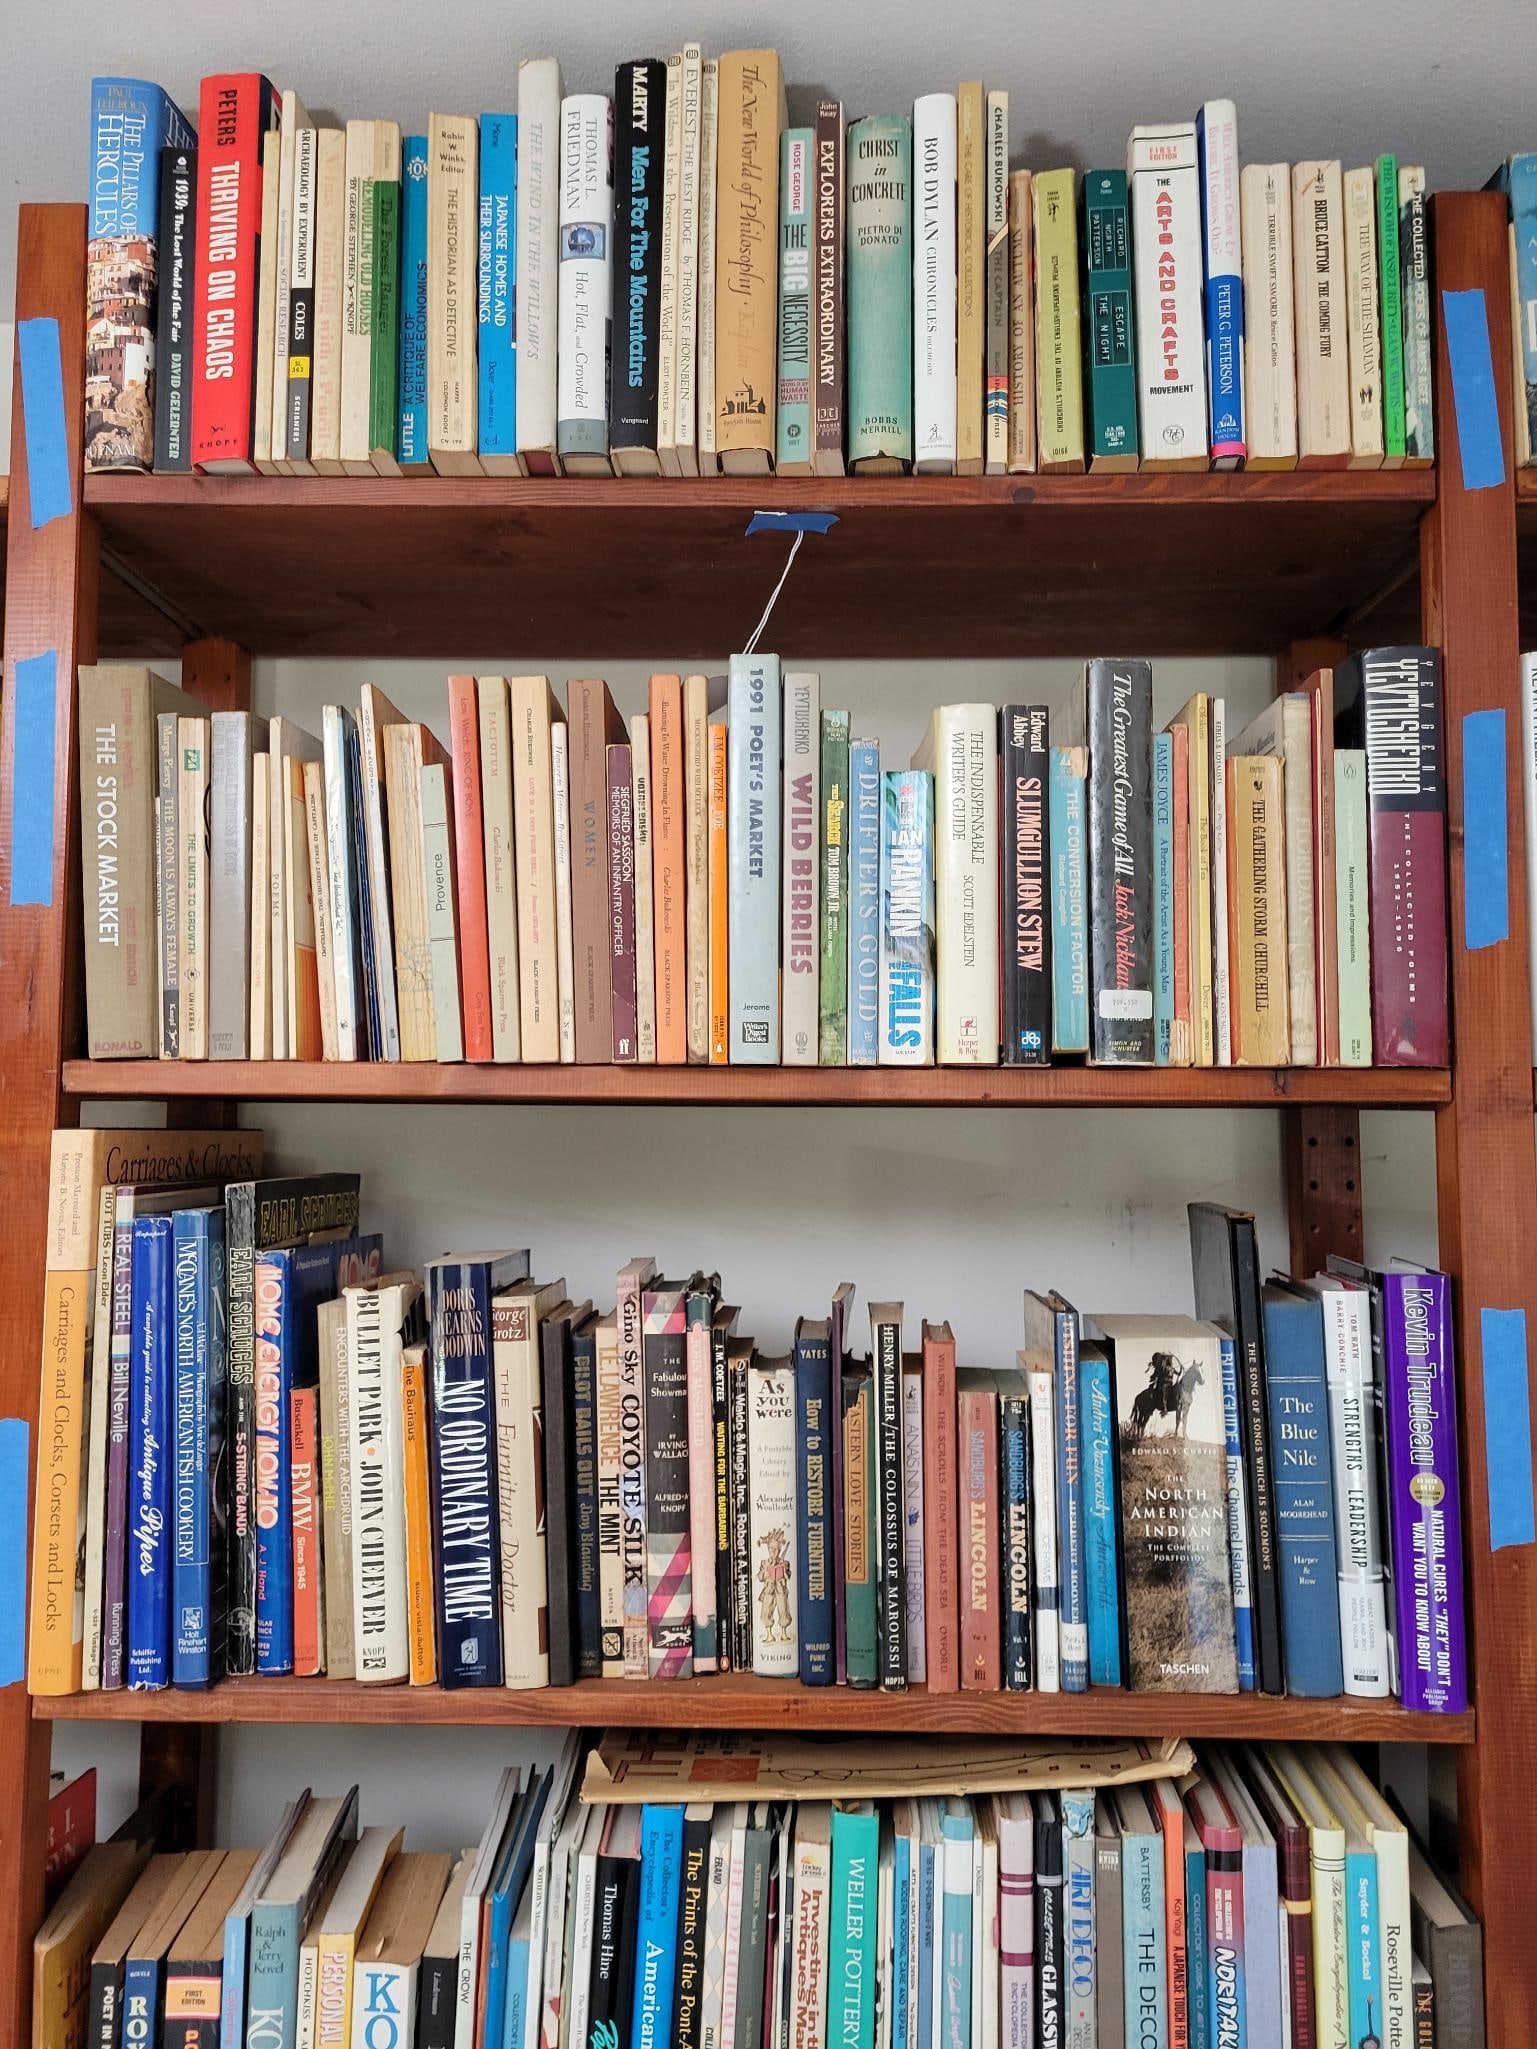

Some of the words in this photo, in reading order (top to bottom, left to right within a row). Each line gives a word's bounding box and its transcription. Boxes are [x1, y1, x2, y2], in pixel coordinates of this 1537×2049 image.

[216, 89, 237, 147] PETERS
[632, 66, 647, 132] MARTY
[123, 114, 145, 147] THE
[859, 140, 900, 159] CHRIST
[924, 137, 938, 173] BOB
[994, 107, 1003, 158] CHARLES
[94, 112, 121, 234] HERCULES
[121, 150, 144, 209] PILLARS
[297, 129, 311, 199] ARCHAEOLOGY
[631, 146, 648, 192] Men
[873, 163, 887, 176] in
[208, 161, 240, 262] THRIVING
[298, 202, 308, 215] BY
[630, 197, 648, 229] For
[820, 141, 835, 240] EXPLORERS
[852, 184, 907, 202] CONCRETE
[924, 180, 938, 242] DYLAN
[995, 160, 1003, 223] BUKOWSKI
[1314, 199, 1328, 231] BRUCE
[120, 212, 138, 234] OF
[783, 224, 808, 249] THE
[1156, 191, 1174, 246] ARTS
[297, 218, 307, 279] EXPERIMENT
[630, 232, 648, 271] The
[783, 250, 808, 291] BIG
[1158, 252, 1175, 292] AND
[1316, 234, 1330, 273] CATTON
[207, 270, 237, 301] ON
[927, 247, 937, 332] CHRONICLES
[1099, 296, 1108, 315] THE
[1218, 284, 1232, 318] PETER
[1318, 281, 1329, 297] THE
[295, 302, 305, 340] COLES
[628, 275, 647, 387] Mountains
[783, 294, 808, 363] NECESSITY
[820, 246, 835, 387] EXTRAORDINARY
[1115, 306, 1126, 348] ESCAPE
[1161, 299, 1179, 381] CRAFTS
[1219, 321, 1230, 333] G.
[1319, 300, 1330, 333] COMING
[205, 310, 234, 380] CHAOS
[1100, 326, 1110, 361] NIGHT
[1219, 336, 1234, 394] PETERSON
[1320, 335, 1331, 358] FURY
[169, 353, 182, 388] DAVID
[1150, 384, 1195, 394] MOVEMENT
[169, 391, 181, 459] GELERNTER
[293, 396, 301, 442] SCRIBNERS
[750, 668, 764, 712] 1991
[1112, 672, 1132, 706] The
[96, 724, 116, 764] THE
[794, 685, 811, 754] YEVTUSHENKO
[1011, 715, 1029, 748] Abbey
[1029, 712, 1045, 752] Edward
[1113, 708, 1133, 778] Greatest
[1366, 658, 1421, 795] YEVTUSHENKO
[749, 725, 764, 790] POET'S
[97, 776, 118, 849] STOCK
[620, 786, 630, 832] SIEGFRIED
[791, 773, 812, 851] WILD
[1114, 780, 1133, 832] Game
[1253, 799, 1264, 824] THE
[187, 833, 195, 852] THE
[584, 800, 596, 867] WOMEN
[622, 835, 632, 882] SASSOON
[749, 799, 763, 878] MARKET
[858, 772, 878, 918] DRIFTER'S
[1016, 777, 1042, 911] SLUMGULLION
[1112, 834, 1132, 846] of
[187, 855, 195, 893] LIMITS
[433, 853, 446, 911] Provence
[1115, 845, 1134, 874] All
[1253, 827, 1265, 894] GATHERING
[99, 855, 119, 946] MARKET
[188, 896, 195, 907] TO
[791, 859, 813, 974] BERRIES
[890, 848, 923, 937] RANKIN
[1254, 897, 1267, 937] STORM
[188, 910, 196, 954] GROWTH
[1016, 914, 1042, 972] STEW
[858, 934, 878, 1022] GOLD
[1255, 943, 1268, 1012] CHURCHILL
[887, 972, 922, 1048] FALLS
[94, 1041, 142, 1052] RONALD
[115, 1233, 131, 1277] REAL
[53, 1286, 74, 1364] Carriages
[114, 1283, 130, 1330] STEEL
[1404, 1288, 1435, 1356] Kevin
[356, 1295, 380, 1377] BULLET
[599, 1345, 620, 1370] T.E.
[800, 1349, 826, 1358] YATES
[54, 1369, 72, 1399] and
[112, 1362, 128, 1387] Bill
[442, 1379, 486, 1414] NO
[111, 1391, 127, 1443] Neville
[292, 1398, 306, 1450] Busenkell
[358, 1386, 381, 1445] PARK
[406, 1389, 417, 1441] Bauhaus
[598, 1371, 620, 1466] LAWRENCE
[806, 1399, 822, 1430] How
[1280, 1397, 1314, 1413] The
[1406, 1364, 1437, 1466] Trudeau
[621, 1394, 641, 1512] COYOTE
[807, 1436, 821, 1450] to
[1280, 1423, 1318, 1440] Blue
[1343, 1398, 1363, 1471] STRENGTHS
[499, 1423, 517, 1528] Furniture
[970, 1430, 984, 1498] SANDBURG'S
[1008, 1430, 1022, 1499] SANDBURG'S
[1282, 1450, 1318, 1466] Nile
[48, 1472, 67, 1537] Corsets
[291, 1463, 311, 1532] BMW
[360, 1462, 382, 1521] JOHN
[439, 1421, 491, 1549] ORDINARY
[600, 1475, 620, 1508] THE
[806, 1454, 823, 1517] RESTORE
[1145, 1488, 1208, 1500] NORTH
[600, 1512, 620, 1555] MINT
[1130, 1507, 1224, 1519] AMERICAN
[1144, 1526, 1212, 1537] INDIAN
[1347, 1489, 1368, 1568] LEADERSHIP
[46, 1542, 62, 1574] and
[622, 1518, 643, 1585] SILK
[807, 1522, 824, 1600] FURNITURE
[971, 1502, 986, 1610] LINCOLN
[1009, 1504, 1026, 1612] LINCOLN
[362, 1527, 384, 1636] CHEEVER
[443, 1557, 492, 1622] TIME
[501, 1542, 520, 1613] Doctor
[45, 1580, 64, 1632] Locks
[1159, 1664, 1210, 1674] TASCHEN
[686, 1848, 702, 1880] The
[1072, 1862, 1091, 1914] ART
[1140, 1848, 1151, 1911] BATTERSBY
[601, 1884, 617, 1940] Thomas
[684, 1887, 700, 1934] Prints
[846, 1858, 865, 1938] WELLER
[1174, 1898, 1182, 1916] Koji
[462, 1942, 471, 1960] THE
[683, 1941, 697, 1959] of
[1138, 1929, 1155, 1972] THE
[1174, 1918, 1182, 1936] Yagi
[599, 1945, 614, 1979] Hine
[682, 1963, 696, 1989] the
[1072, 1920, 1092, 1998] DECO
[1386, 1924, 1402, 2001] Roseville
[103, 1986, 114, 2019] POET
[303, 1958, 312, 2019] HOTCHKISS
[320, 1952, 347, 2045] PERSONAL
[460, 1968, 470, 2004] CROW
[843, 1948, 862, 2049] POTTERY
[102, 2025, 113, 2038] IN
